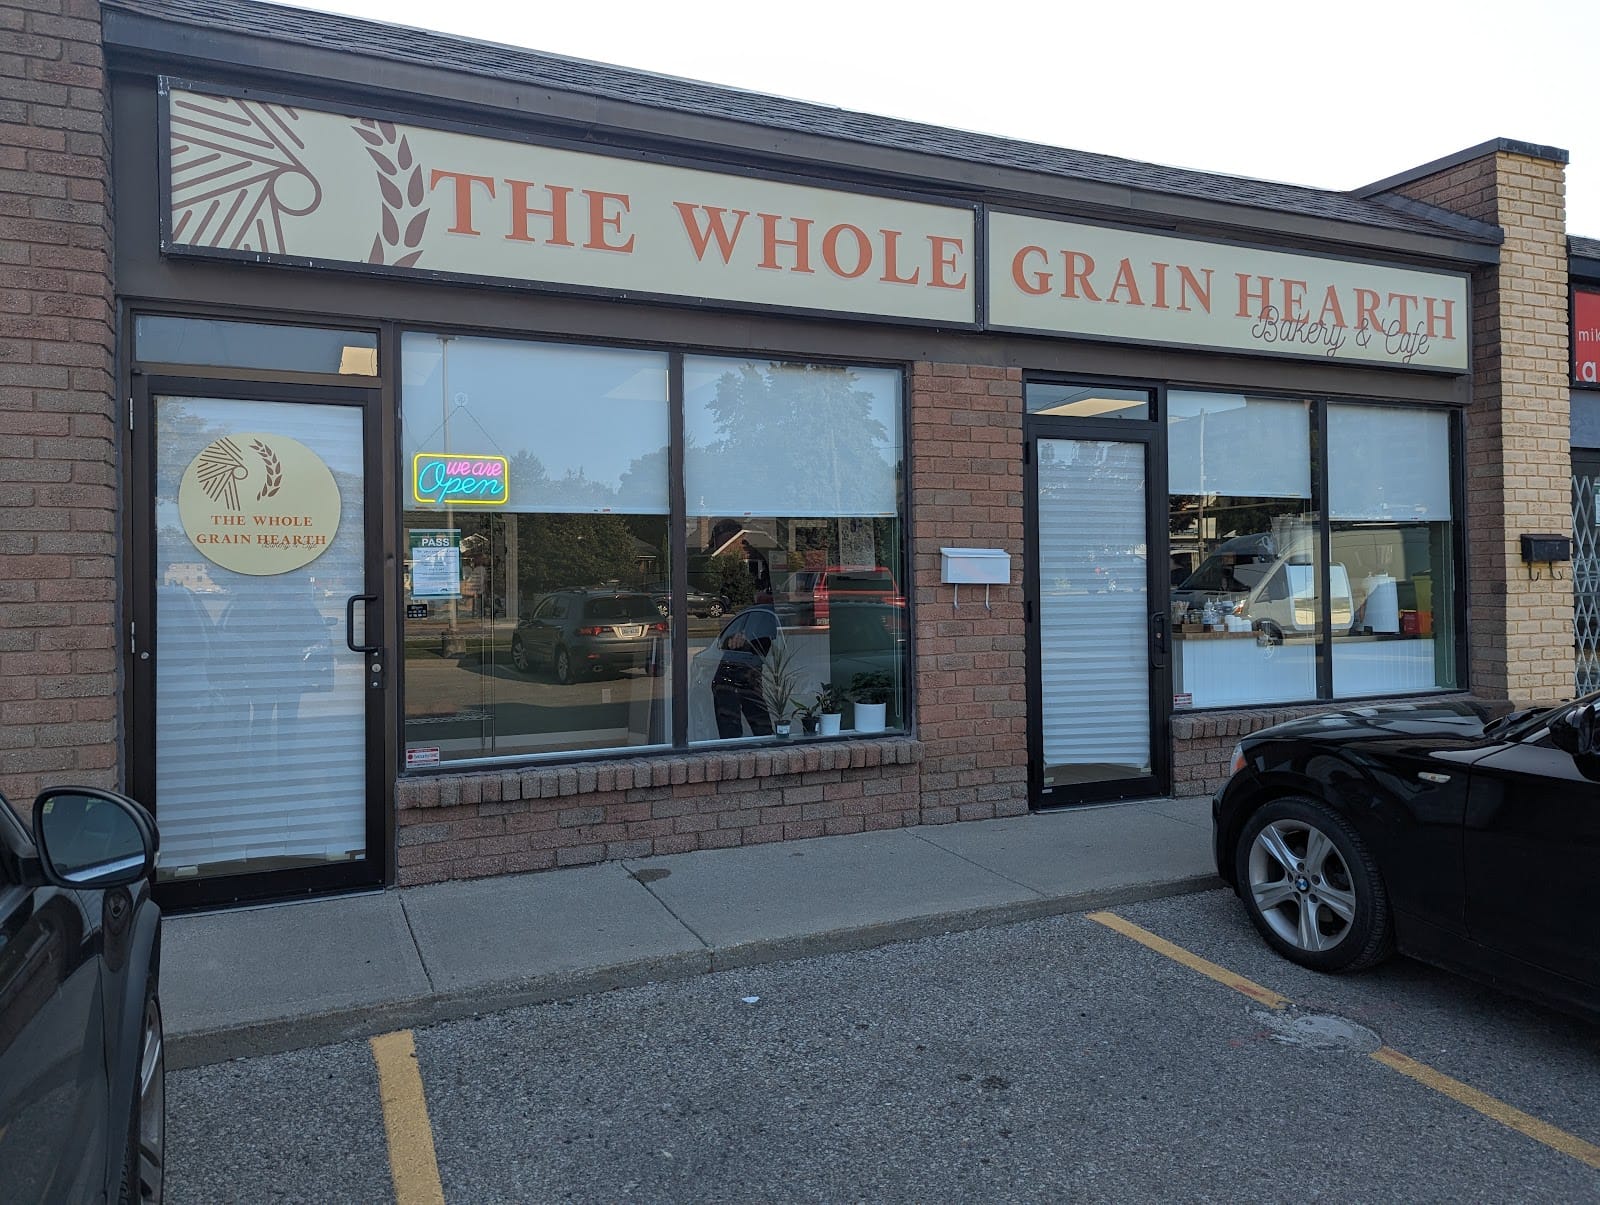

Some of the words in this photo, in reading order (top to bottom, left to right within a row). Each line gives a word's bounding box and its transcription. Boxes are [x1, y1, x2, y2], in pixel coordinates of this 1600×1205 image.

[430, 168, 637, 254] THE
[671, 201, 968, 290] WHOLE
[1011, 245, 1215, 315] GRAIN
[1234, 272, 1457, 341] HEARTH
[1251, 304, 1347, 358] Bakery
[1355, 317, 1372, 350] &
[1381, 317, 1431, 364] Cafe
[446, 461, 472, 476] we
[472, 462, 503, 477] are
[418, 461, 504, 502] Open
[211, 515, 246, 526] THE
[252, 515, 313, 527] WHOLE
[196, 533, 251, 545] GRAIN
[256, 534, 327, 545] HEARTH
[421, 538, 450, 547] PASS
